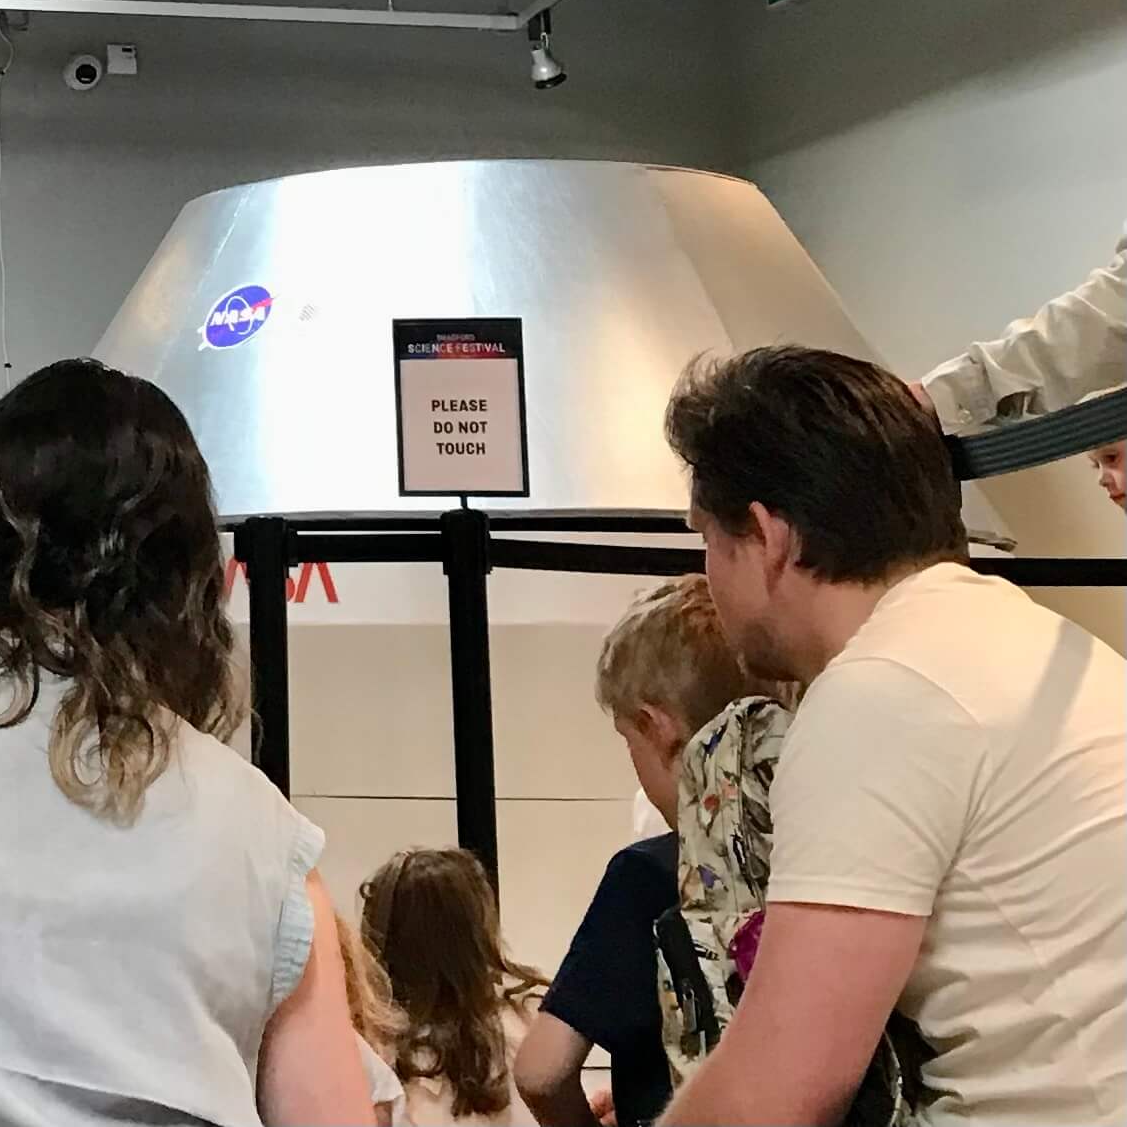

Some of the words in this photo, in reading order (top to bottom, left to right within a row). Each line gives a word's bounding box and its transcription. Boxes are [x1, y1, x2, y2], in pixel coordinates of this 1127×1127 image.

[208, 306, 266, 326] NASA
[407, 343, 453, 354] SCIENCE
[456, 342, 505, 352] FESTIVAL
[431, 399, 487, 412] PLEASE
[433, 421, 453, 434] DO
[458, 421, 487, 434] NOT
[436, 442, 486, 455] TOUCH
